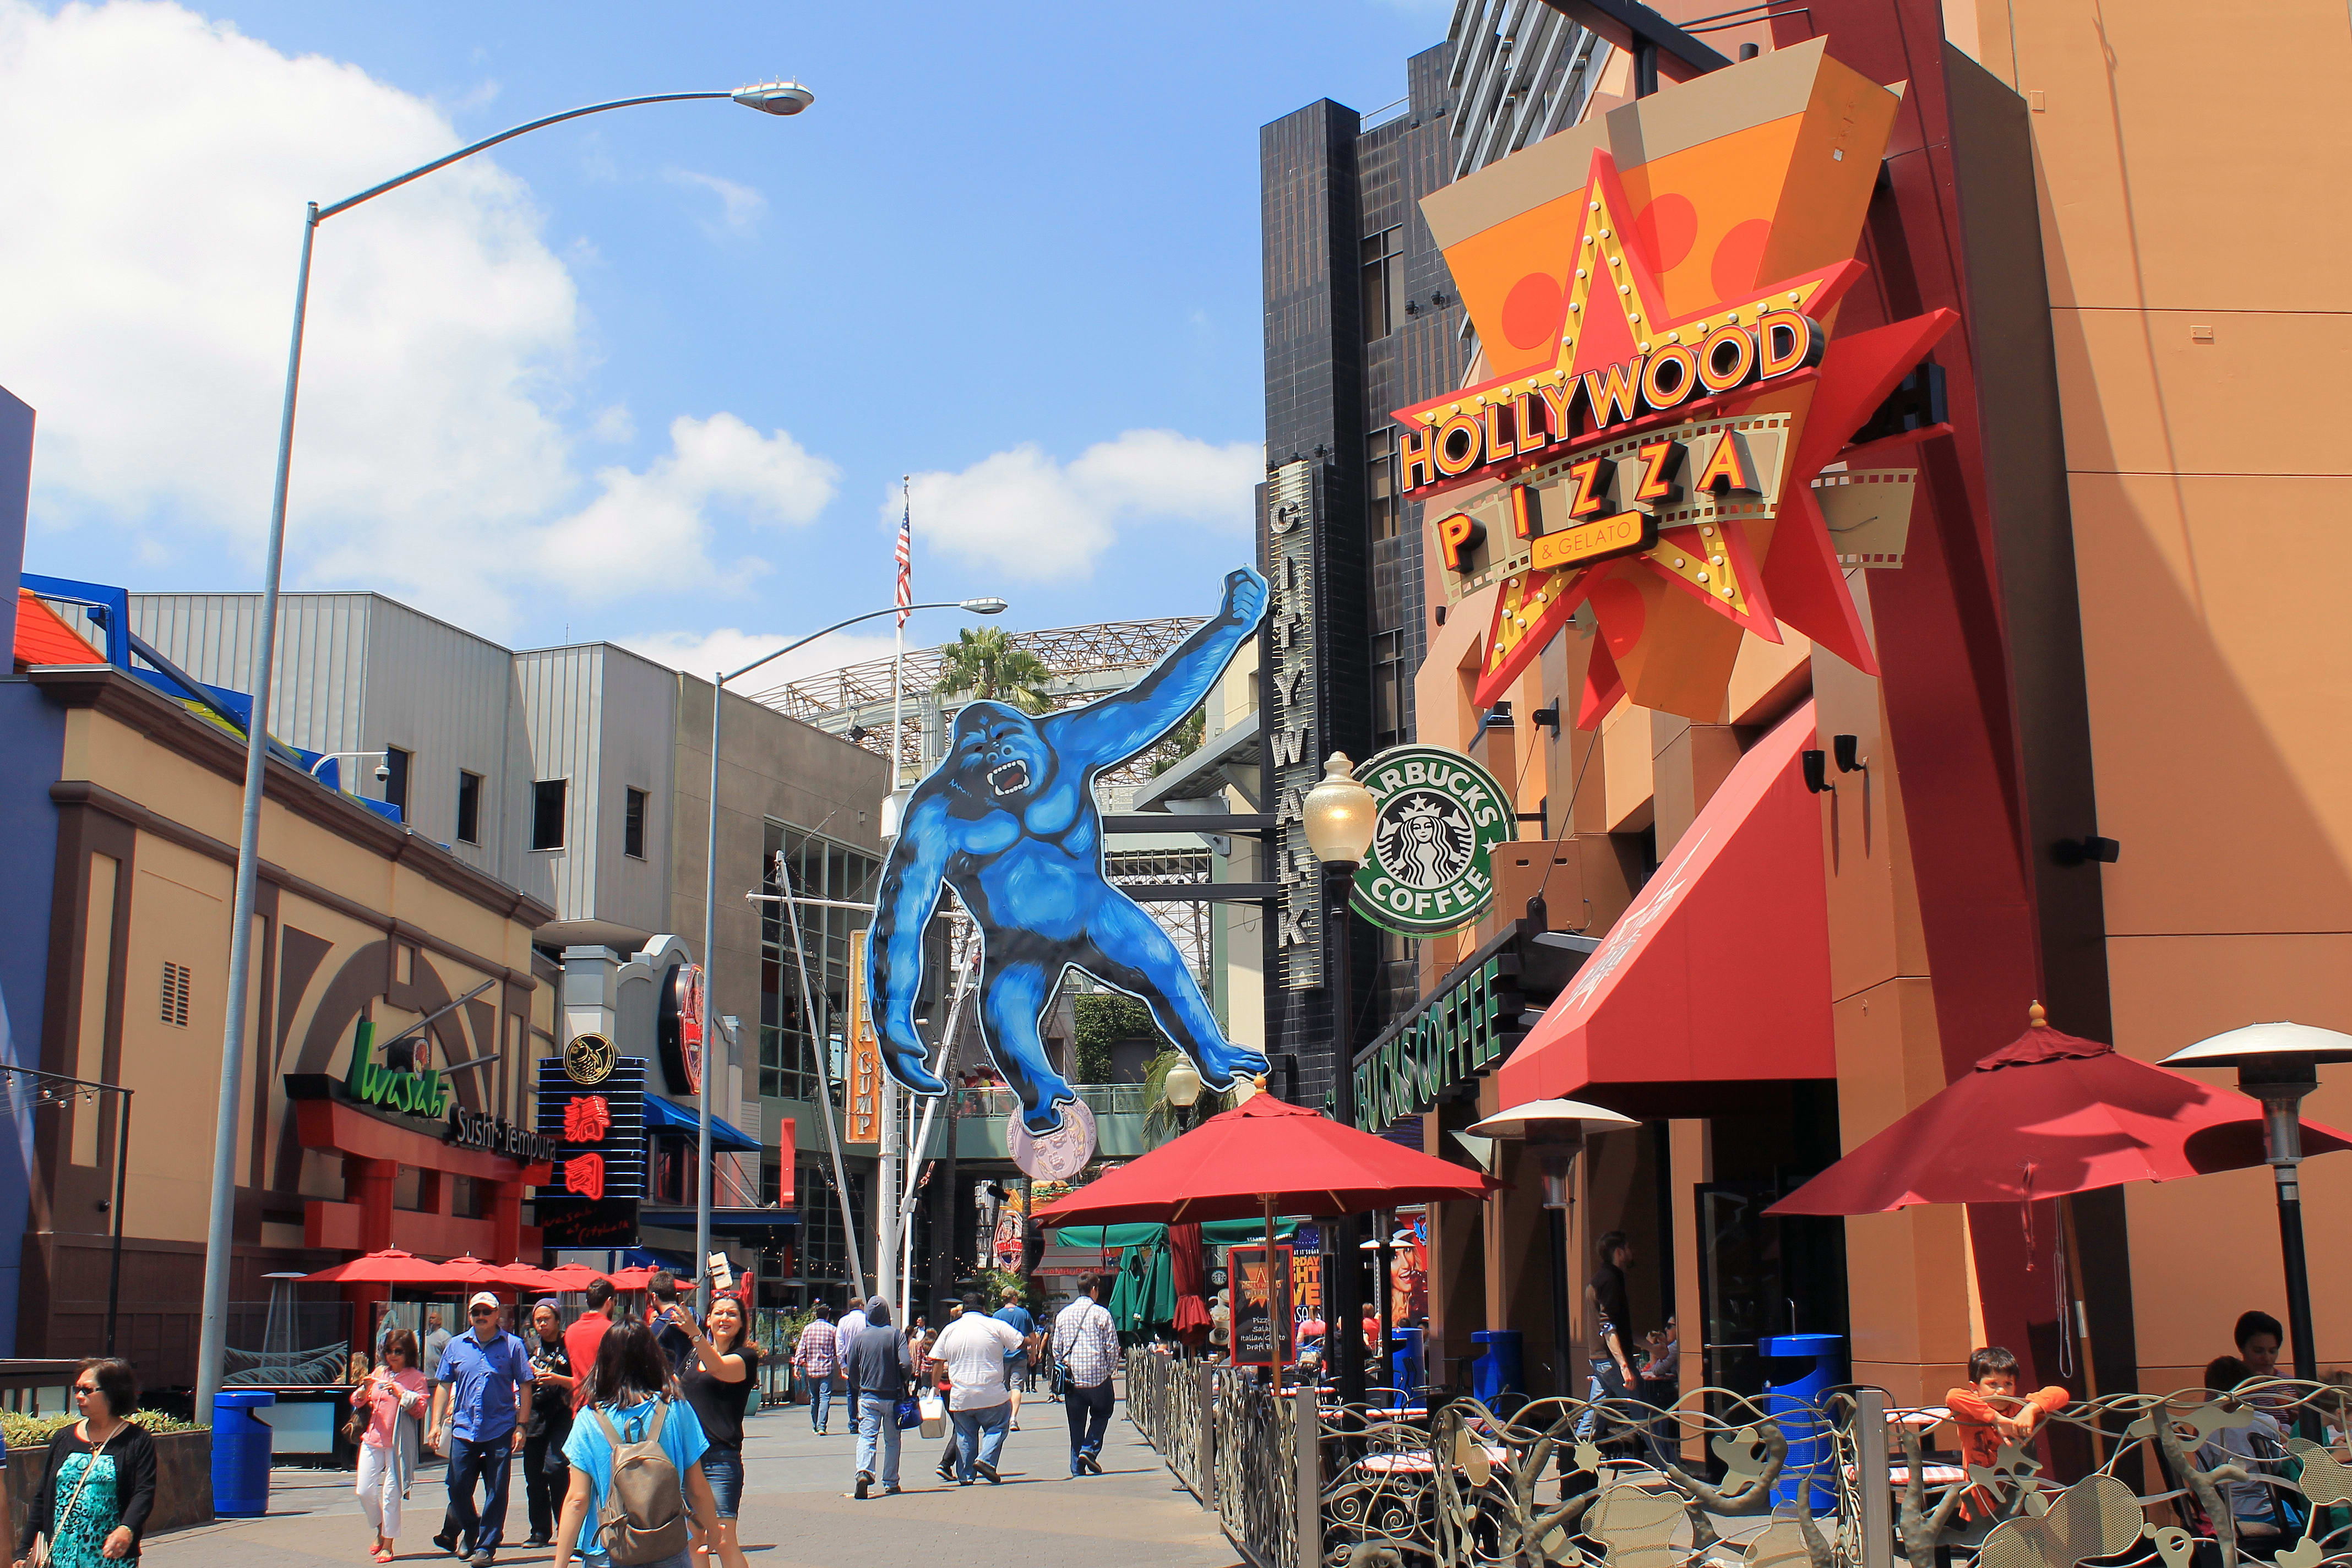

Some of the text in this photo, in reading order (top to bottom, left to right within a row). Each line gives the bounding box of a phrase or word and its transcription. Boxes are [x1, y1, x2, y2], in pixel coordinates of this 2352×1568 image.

[1398, 308, 1812, 493] HOLLYWOOD
[1438, 429, 1747, 570] PIZZA
[1542, 521, 1631, 560] & GELATO
[1270, 500, 1309, 946] CITYWALK
[1364, 761, 1499, 828] ARBUCKS
[1371, 865, 1491, 915] COFFEE
[1416, 955, 1501, 1104] COFFEE
[457, 1106, 556, 1166] Sushi Tempura
[1293, 1256, 1320, 1266] RDAY
[1294, 1282, 1321, 1305] VE
[1246, 1342, 1264, 1352] Draft
